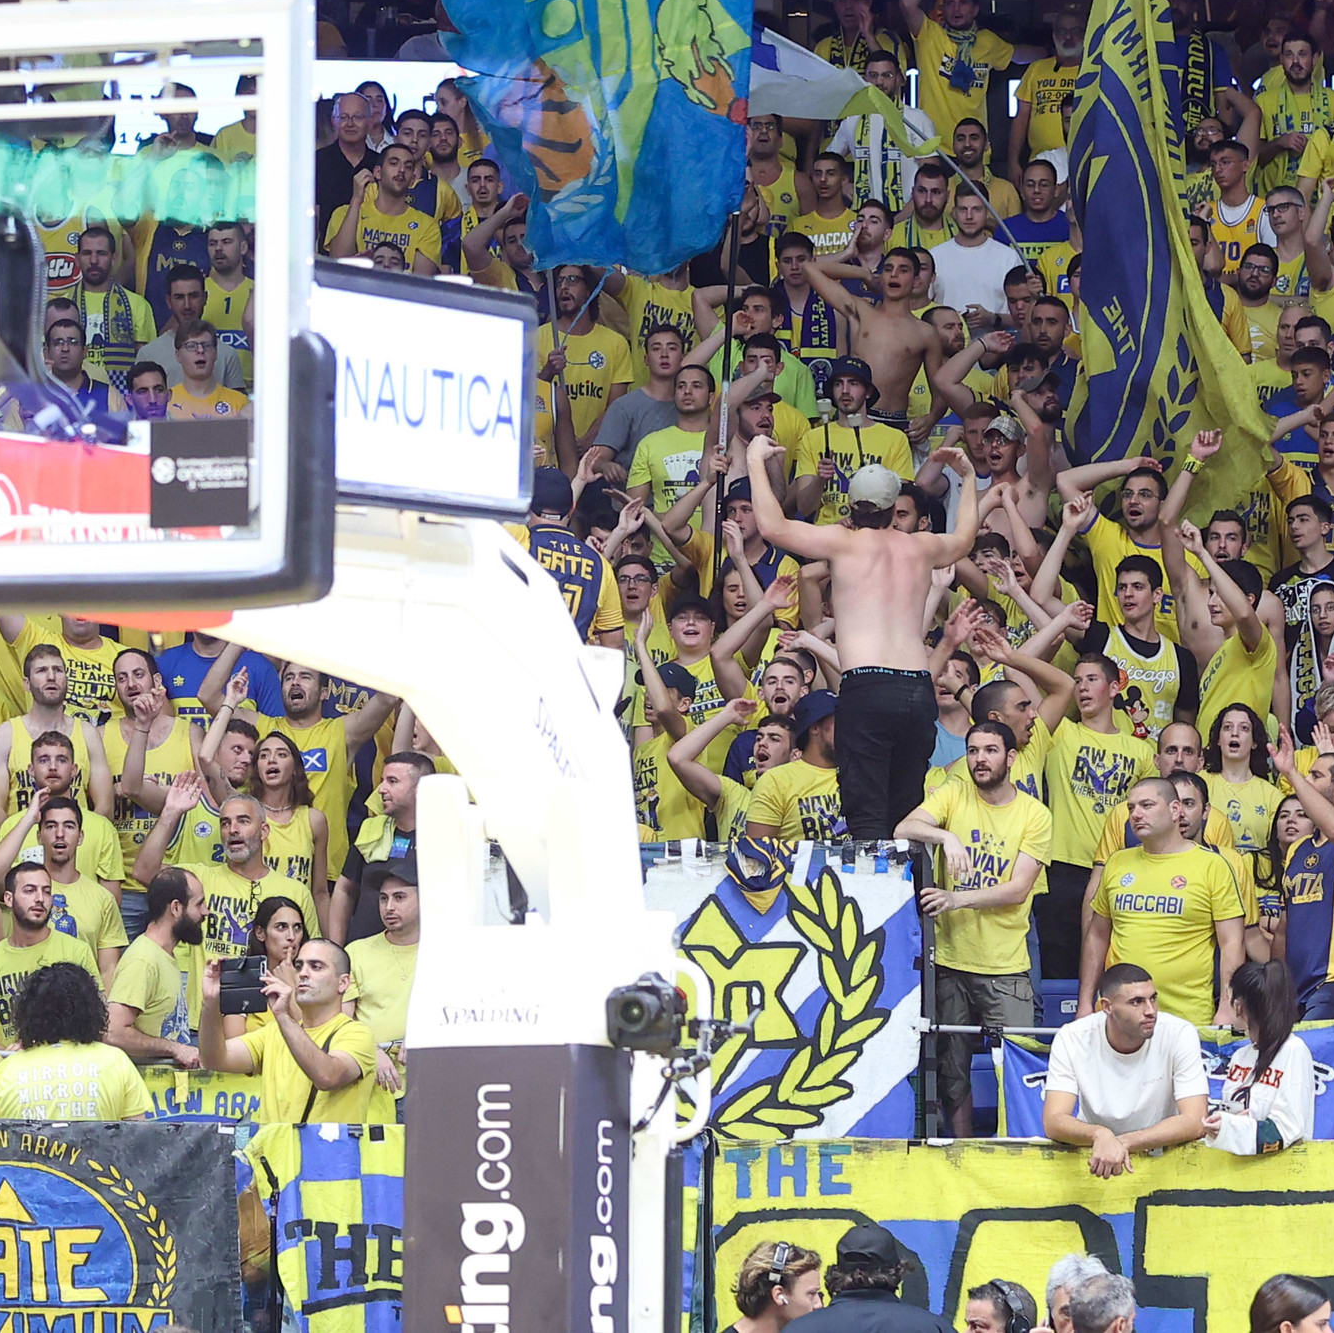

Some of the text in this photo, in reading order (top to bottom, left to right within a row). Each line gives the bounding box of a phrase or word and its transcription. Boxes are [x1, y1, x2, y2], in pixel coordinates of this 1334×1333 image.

[343, 355, 517, 442] NAUTICA
[549, 539, 583, 555] THE
[538, 552, 594, 581] GATE
[1114, 892, 1184, 915] MACCABI
[17, 1081, 100, 1101] MIRROR
[20, 1130, 82, 1166] ARMY
[725, 1143, 854, 1201] THE
